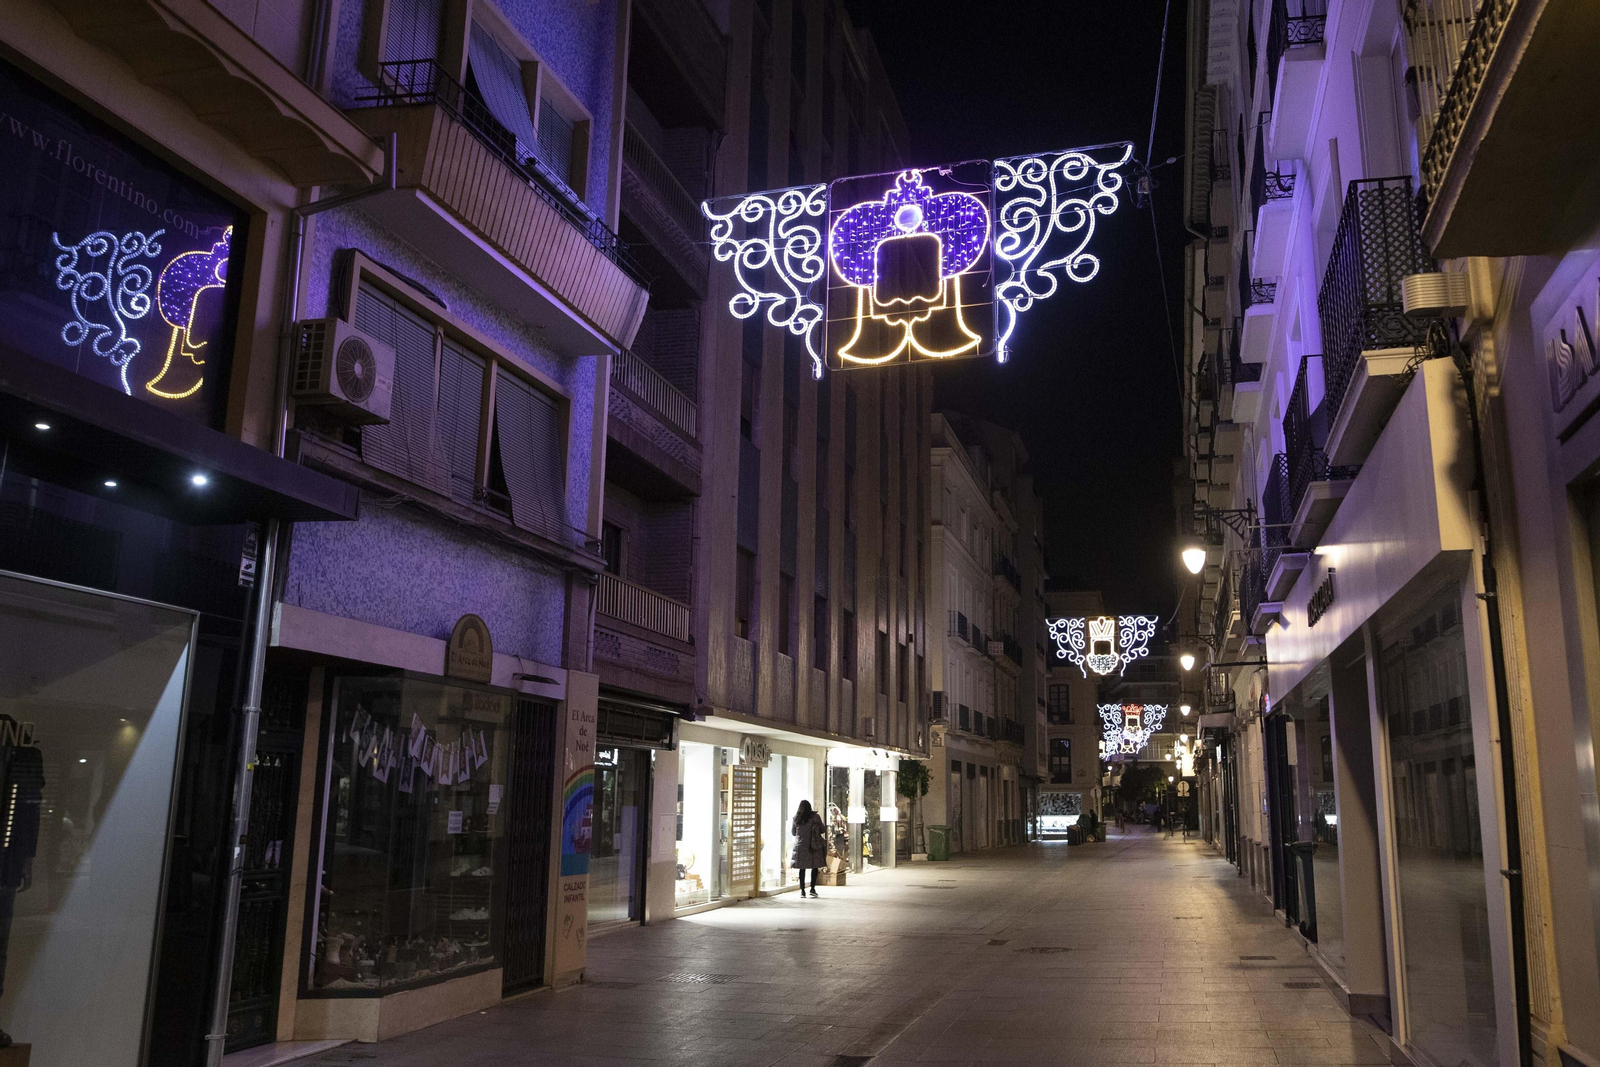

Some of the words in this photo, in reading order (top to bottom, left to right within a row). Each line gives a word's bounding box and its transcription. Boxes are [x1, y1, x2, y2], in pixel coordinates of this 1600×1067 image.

[0, 111, 201, 240] ww.florentino.com
[572, 709, 579, 721] El
[580, 710, 595, 723] Arca
[579, 725, 587, 736] de
[575, 739, 590, 752] Noé
[563, 881, 586, 891] CALZADO
[563, 893, 585, 903] INFANTIL
